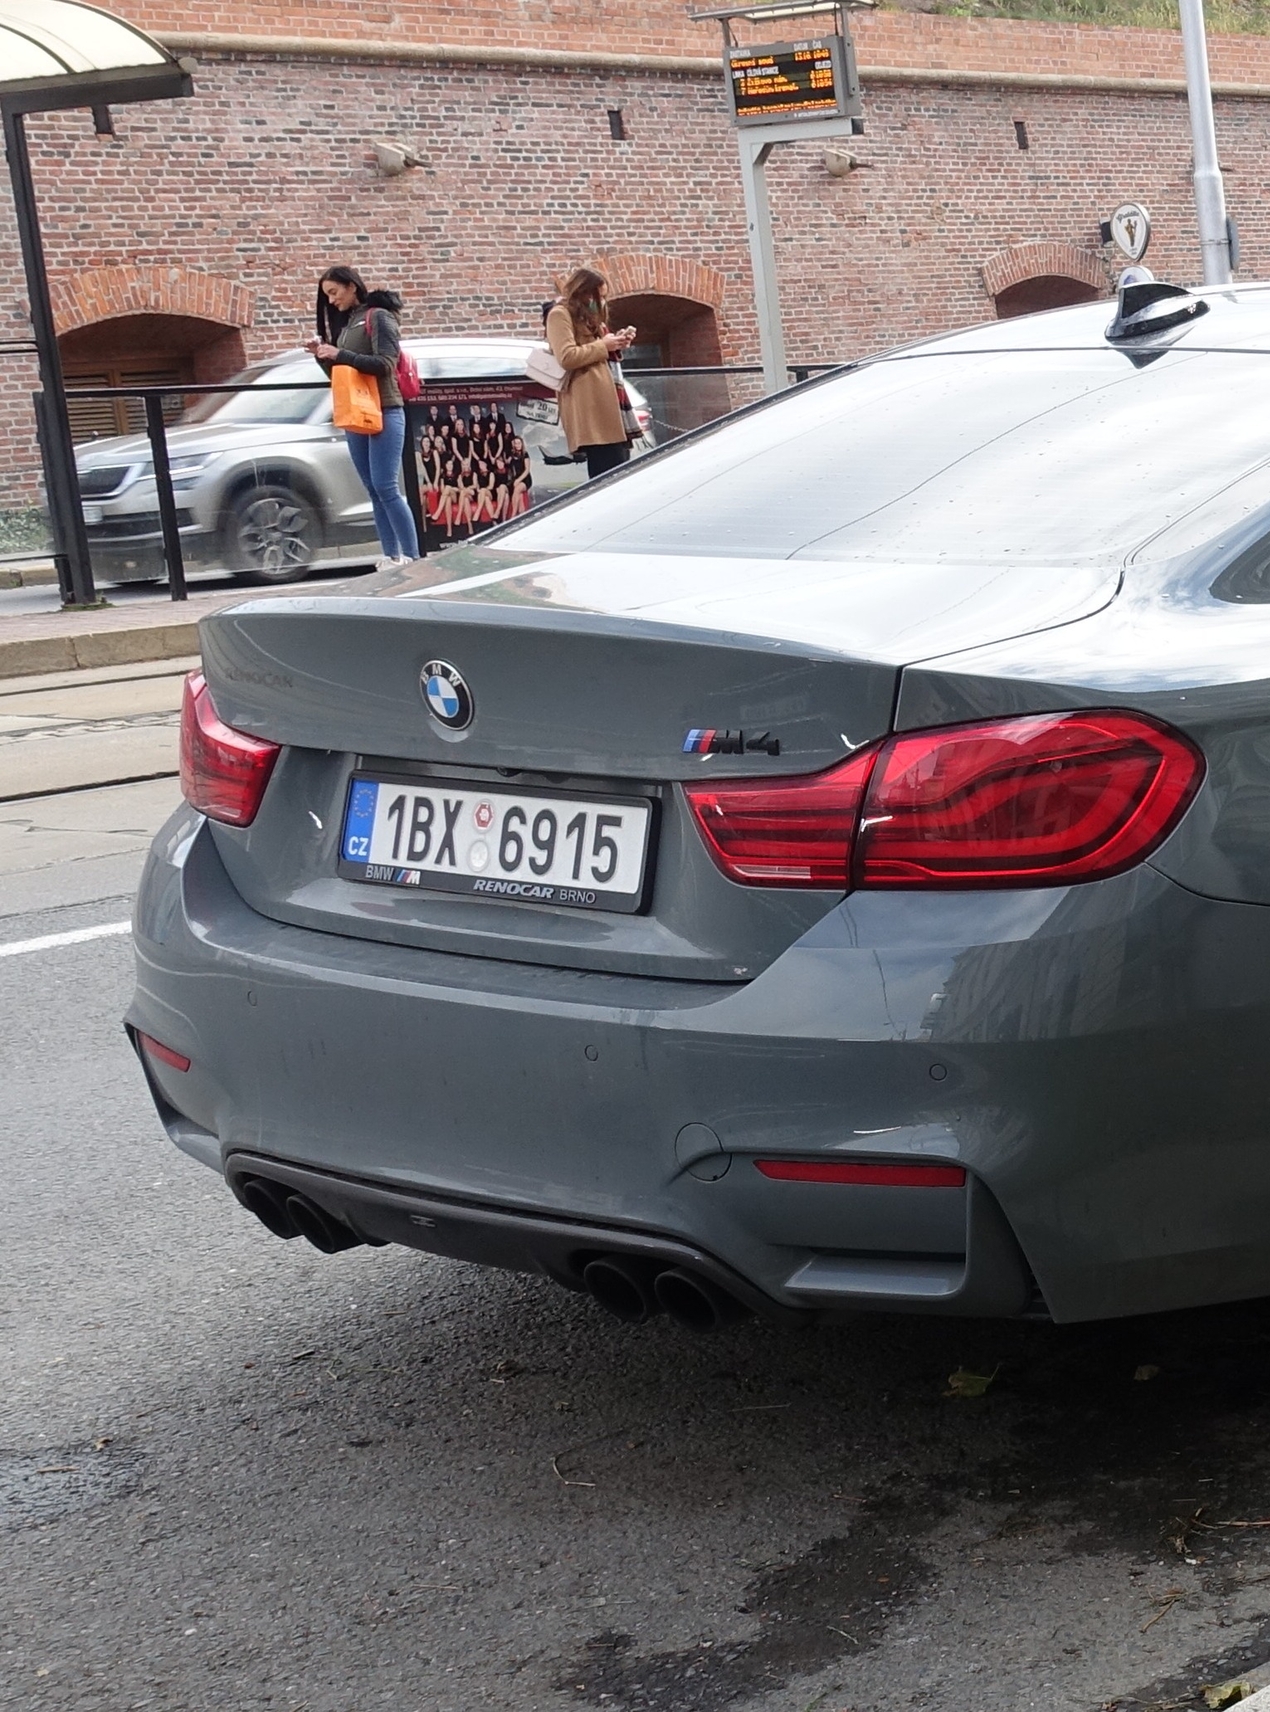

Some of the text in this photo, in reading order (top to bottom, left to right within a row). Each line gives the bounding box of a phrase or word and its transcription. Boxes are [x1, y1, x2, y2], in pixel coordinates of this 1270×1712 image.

[420, 663, 461, 687] BMW
[348, 836, 369, 856] CZ
[387, 794, 625, 884] 1BX 6915
[365, 864, 395, 881] BMW
[473, 879, 596, 904] RENOCAR BRNO
